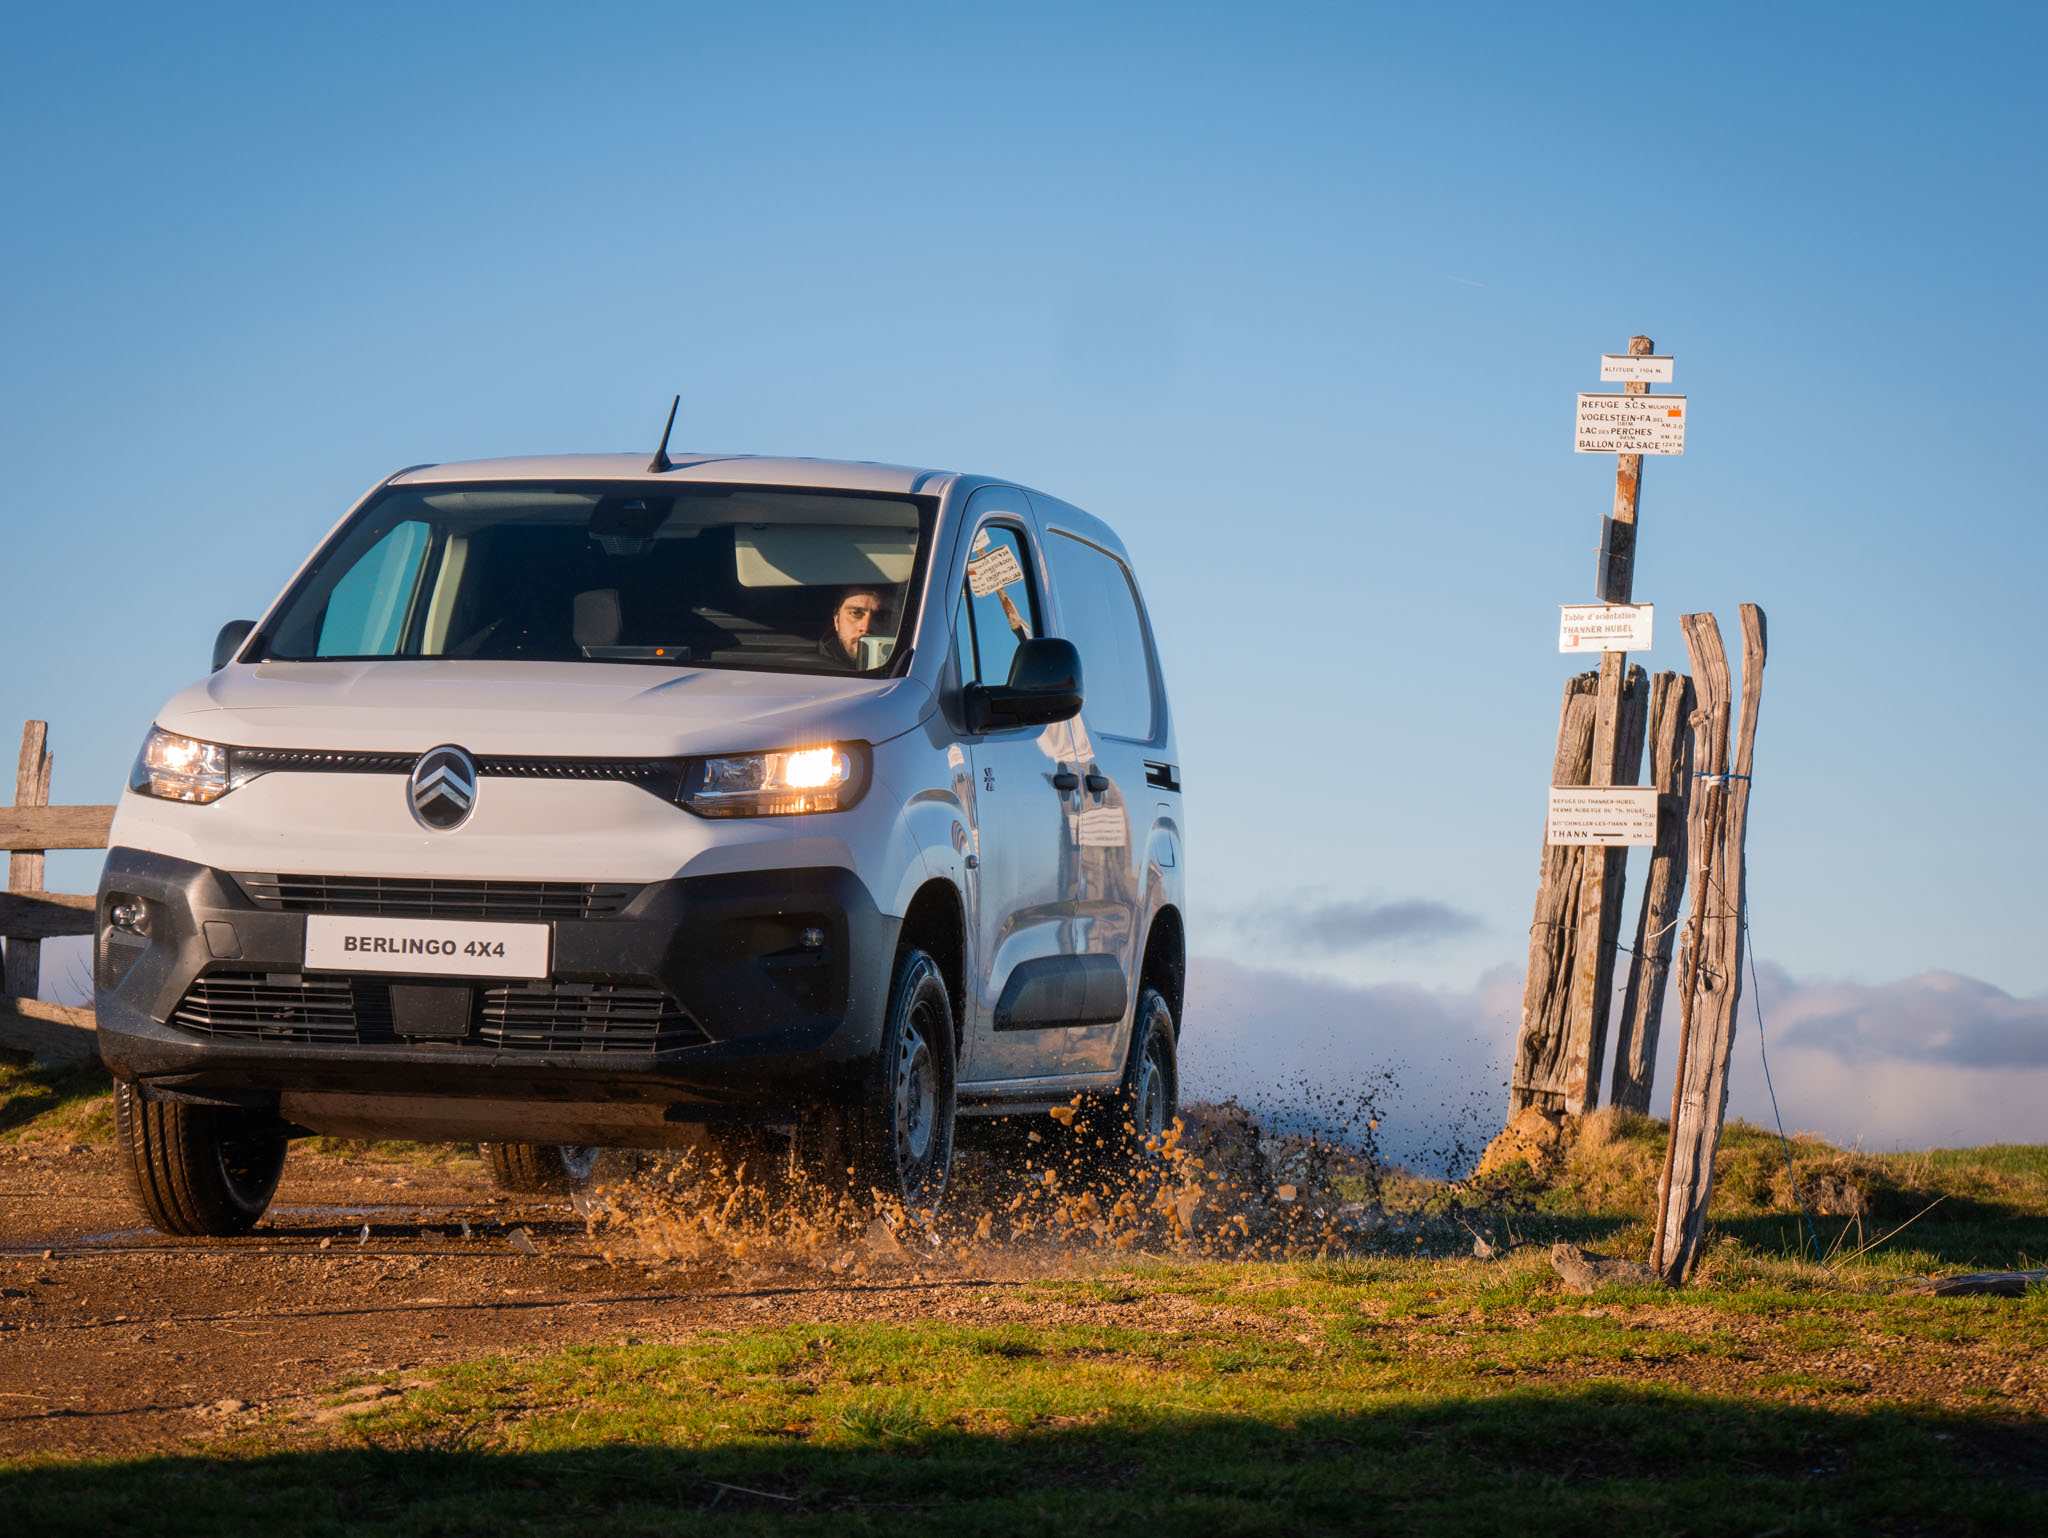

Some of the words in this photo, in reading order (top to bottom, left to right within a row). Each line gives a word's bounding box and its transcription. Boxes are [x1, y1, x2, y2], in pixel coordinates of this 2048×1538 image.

[1581, 401, 1620, 409] REFUGE
[1610, 428, 1652, 436] PERCHES
[1579, 440, 1614, 448] BALLON
[1563, 625, 1602, 634] THANNER
[1605, 624, 1633, 633] HUBEL
[1552, 830, 1588, 838] THANN
[344, 936, 457, 955] BERLINGO
[464, 941, 505, 957] 4X4
